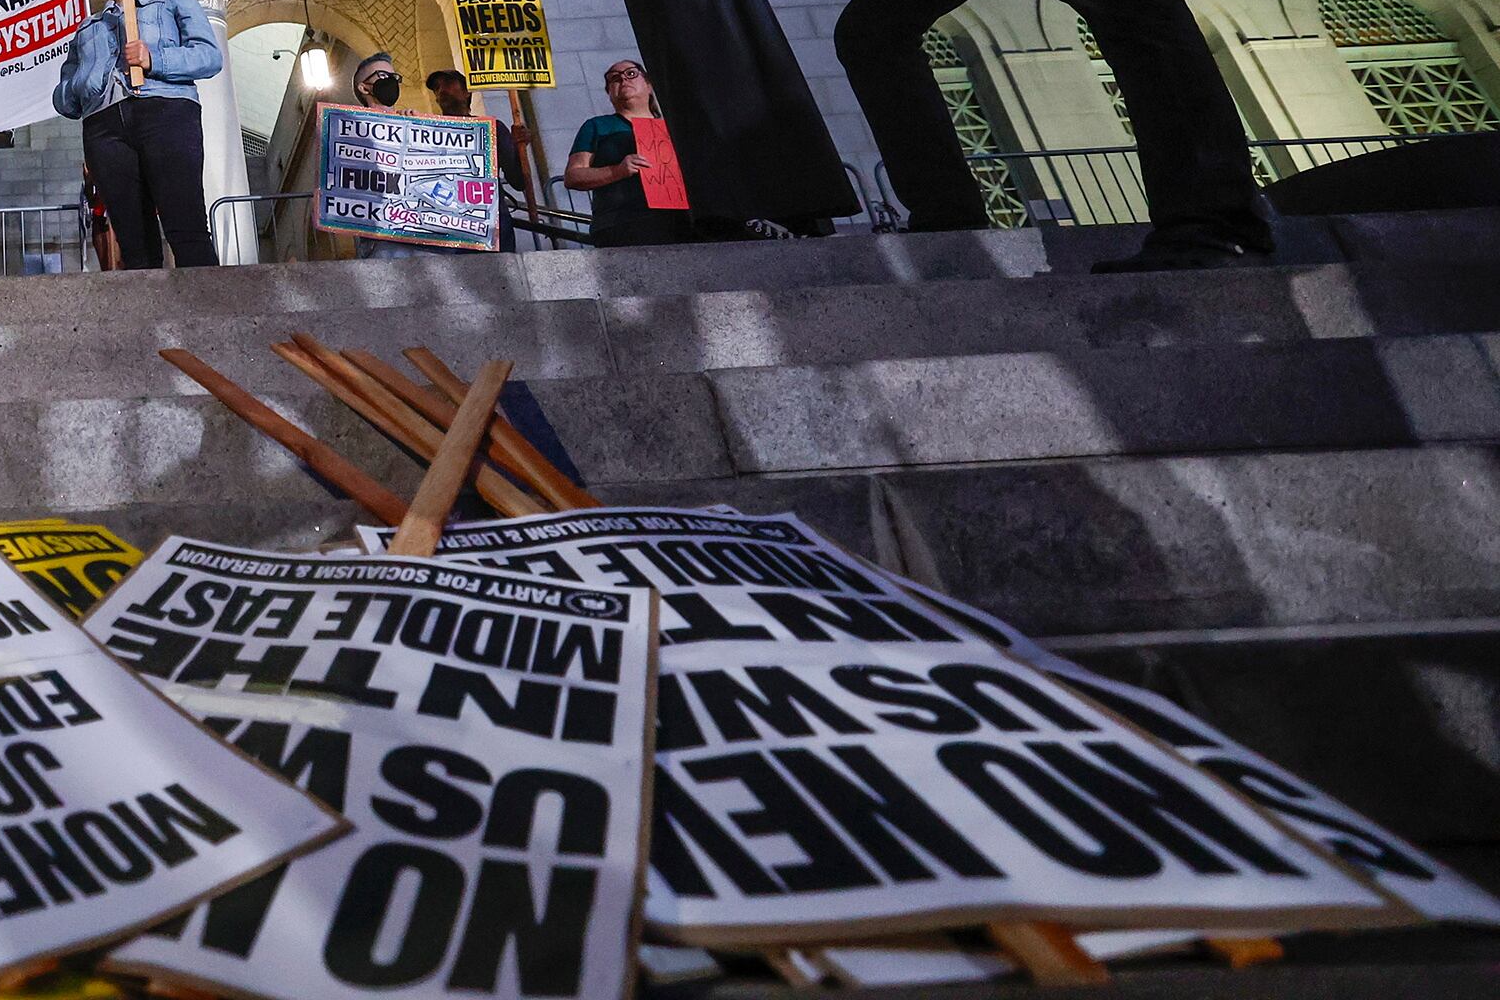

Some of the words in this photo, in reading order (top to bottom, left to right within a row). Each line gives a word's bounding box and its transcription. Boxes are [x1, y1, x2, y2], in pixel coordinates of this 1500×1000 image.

[458, 3, 541, 34] NEEDS
[465, 38, 499, 46] NOT
[503, 37, 544, 45] WAR
[0, 43, 69, 76] @PSL_LOSANG
[467, 48, 495, 71] W/
[503, 48, 548, 69] IRAN
[340, 119, 403, 142] FUCK
[411, 128, 474, 148] TRUMP
[338, 146, 371, 160] Fuck
[375, 152, 396, 164] NO
[343, 169, 401, 194] FUCK
[457, 180, 494, 204] ICE
[326, 197, 380, 221] Fuck
[422, 214, 436, 222] I'm
[440, 216, 487, 233] QUEER
[438, 531, 502, 549] LIBER
[504, 528, 520, 543] &
[529, 516, 634, 539] SOCIALISM
[636, 515, 680, 532] FOR
[171, 547, 292, 578] LIBERATION
[296, 564, 311, 579] &
[316, 564, 430, 584] SOCIALISM
[579, 541, 883, 594] MIDDLE
[437, 571, 481, 593] FOR
[486, 573, 561, 606] PARTY
[126, 571, 315, 640] EAST
[748, 592, 958, 642] IN
[312, 590, 622, 684] MIDDLE
[104, 615, 396, 710] THE
[416, 662, 616, 746] IN
[830, 663, 1101, 736] US
[369, 744, 609, 859] US
[936, 741, 1309, 881] NO
[323, 842, 597, 999] NO
